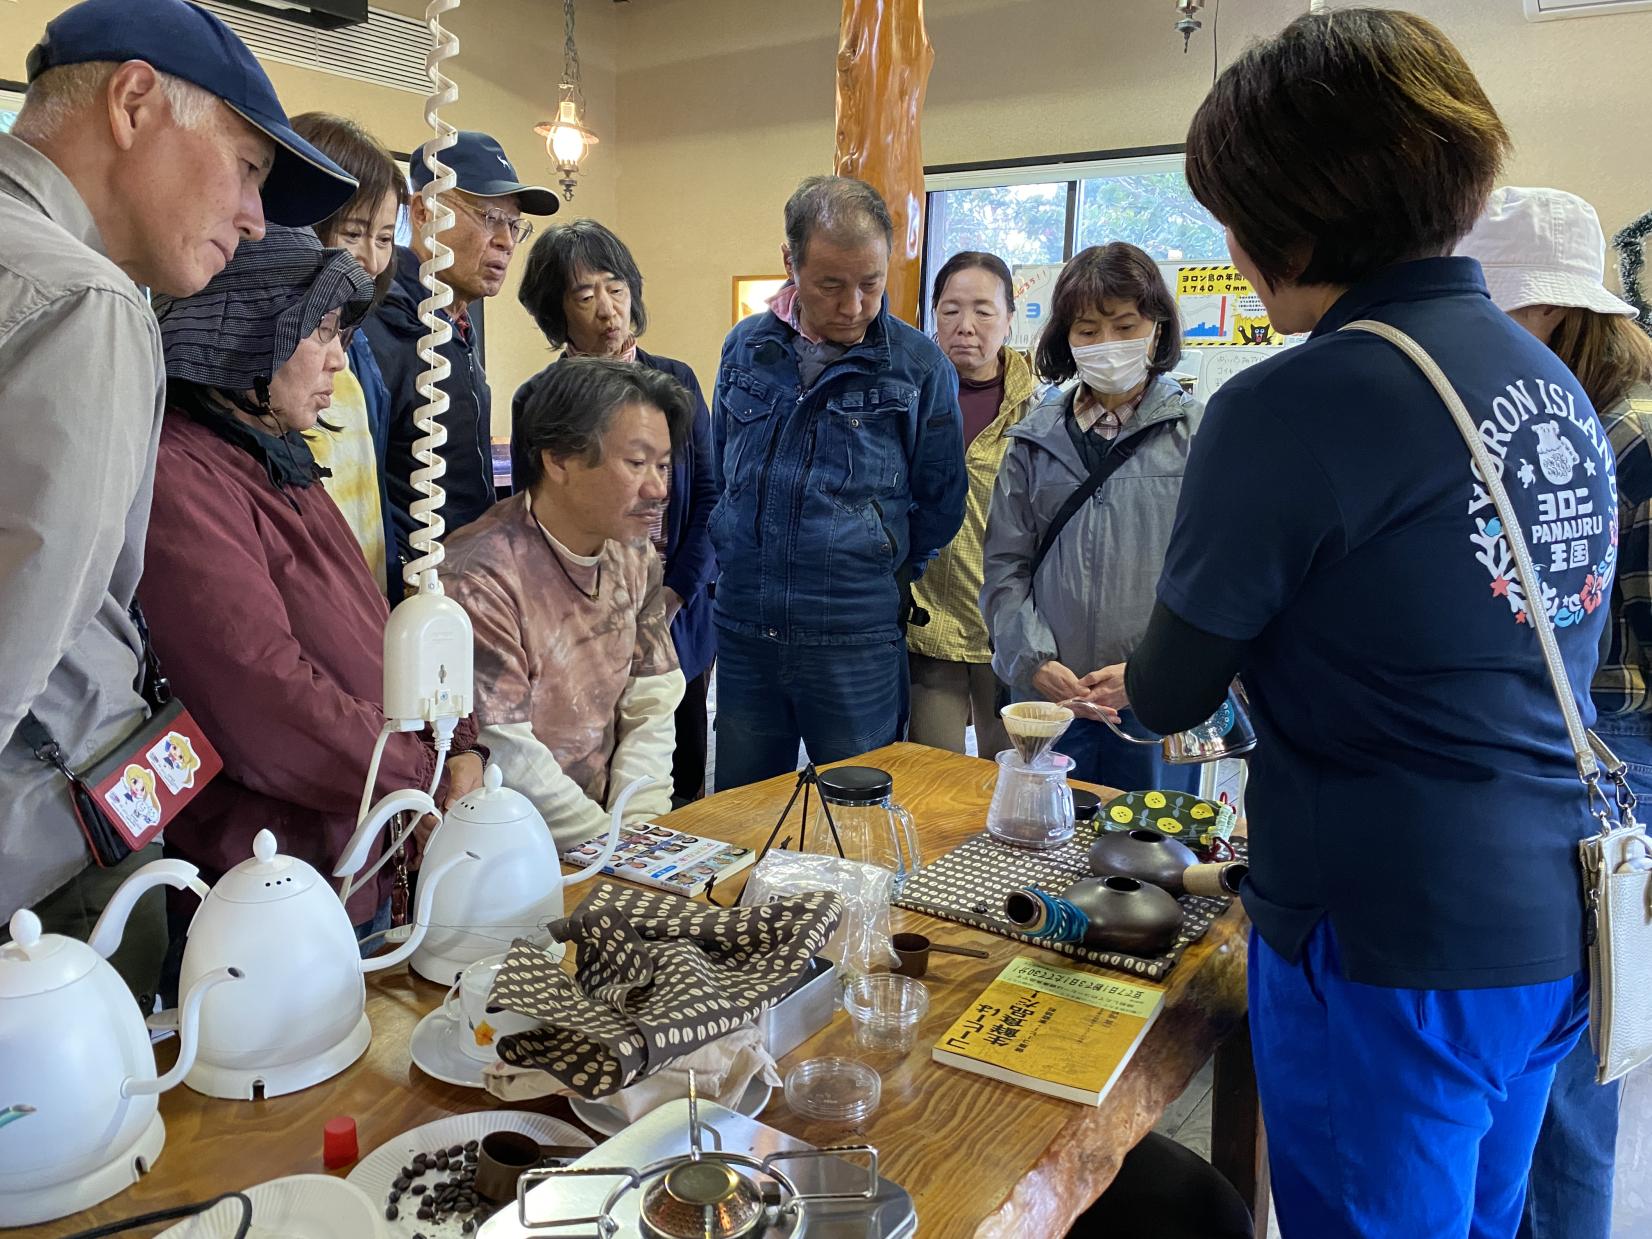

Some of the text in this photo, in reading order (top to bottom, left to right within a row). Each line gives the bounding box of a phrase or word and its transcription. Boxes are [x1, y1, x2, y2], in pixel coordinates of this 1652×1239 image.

[1535, 378, 1618, 502] ISLAND
[1532, 515, 1602, 544] PANAURU
[1549, 539, 1589, 572] 王国
[946, 1003, 1001, 1049] コーヒーは
